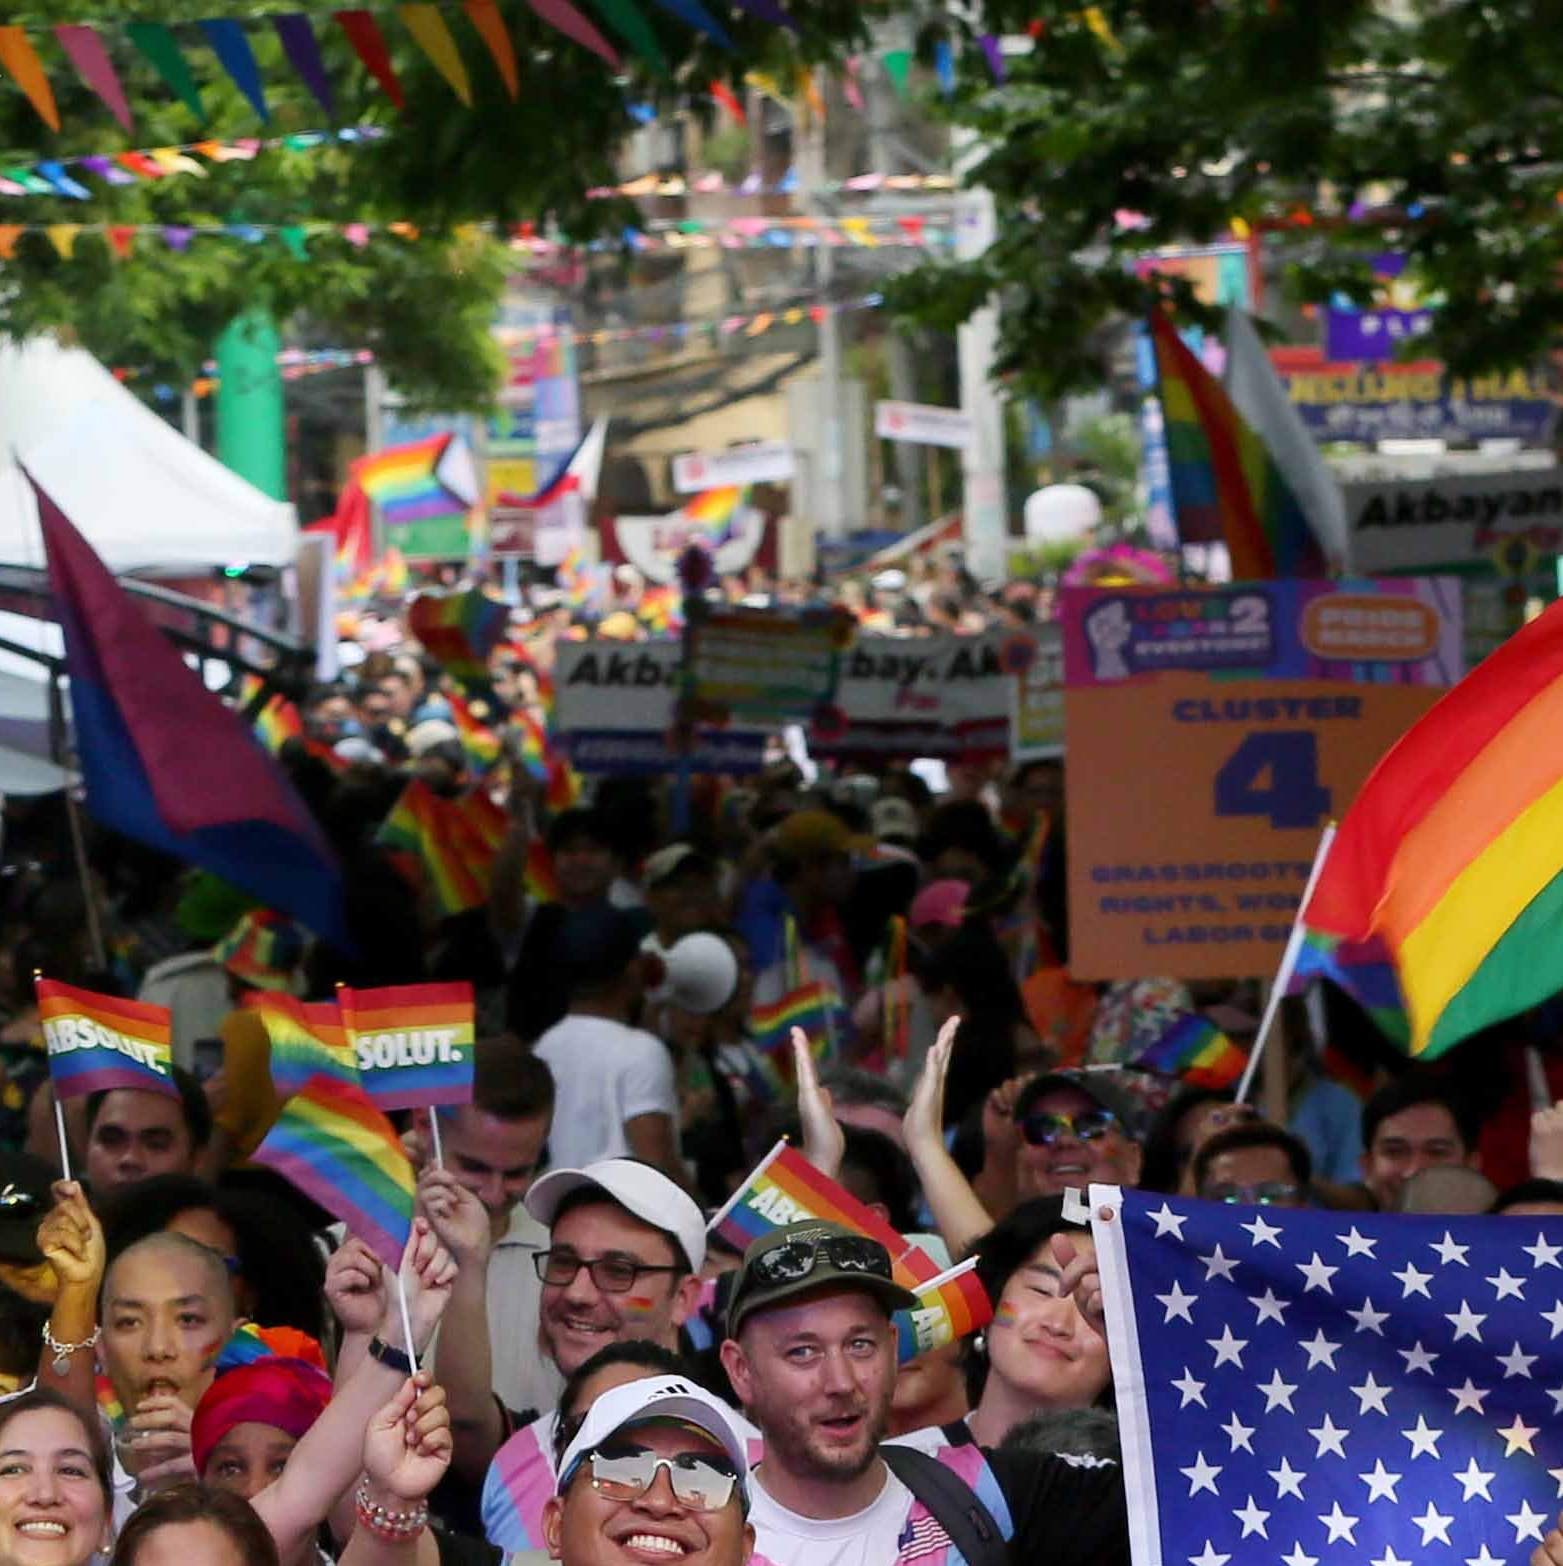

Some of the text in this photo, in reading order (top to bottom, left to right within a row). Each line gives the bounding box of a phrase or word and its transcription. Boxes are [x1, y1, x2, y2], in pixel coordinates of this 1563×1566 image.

[568, 653, 680, 689] Akb
[1173, 697, 1363, 722] CLUSTER
[1214, 731, 1332, 829] 4
[1143, 925, 1253, 945] LABOR
[356, 1028, 463, 1071] SOLUT.
